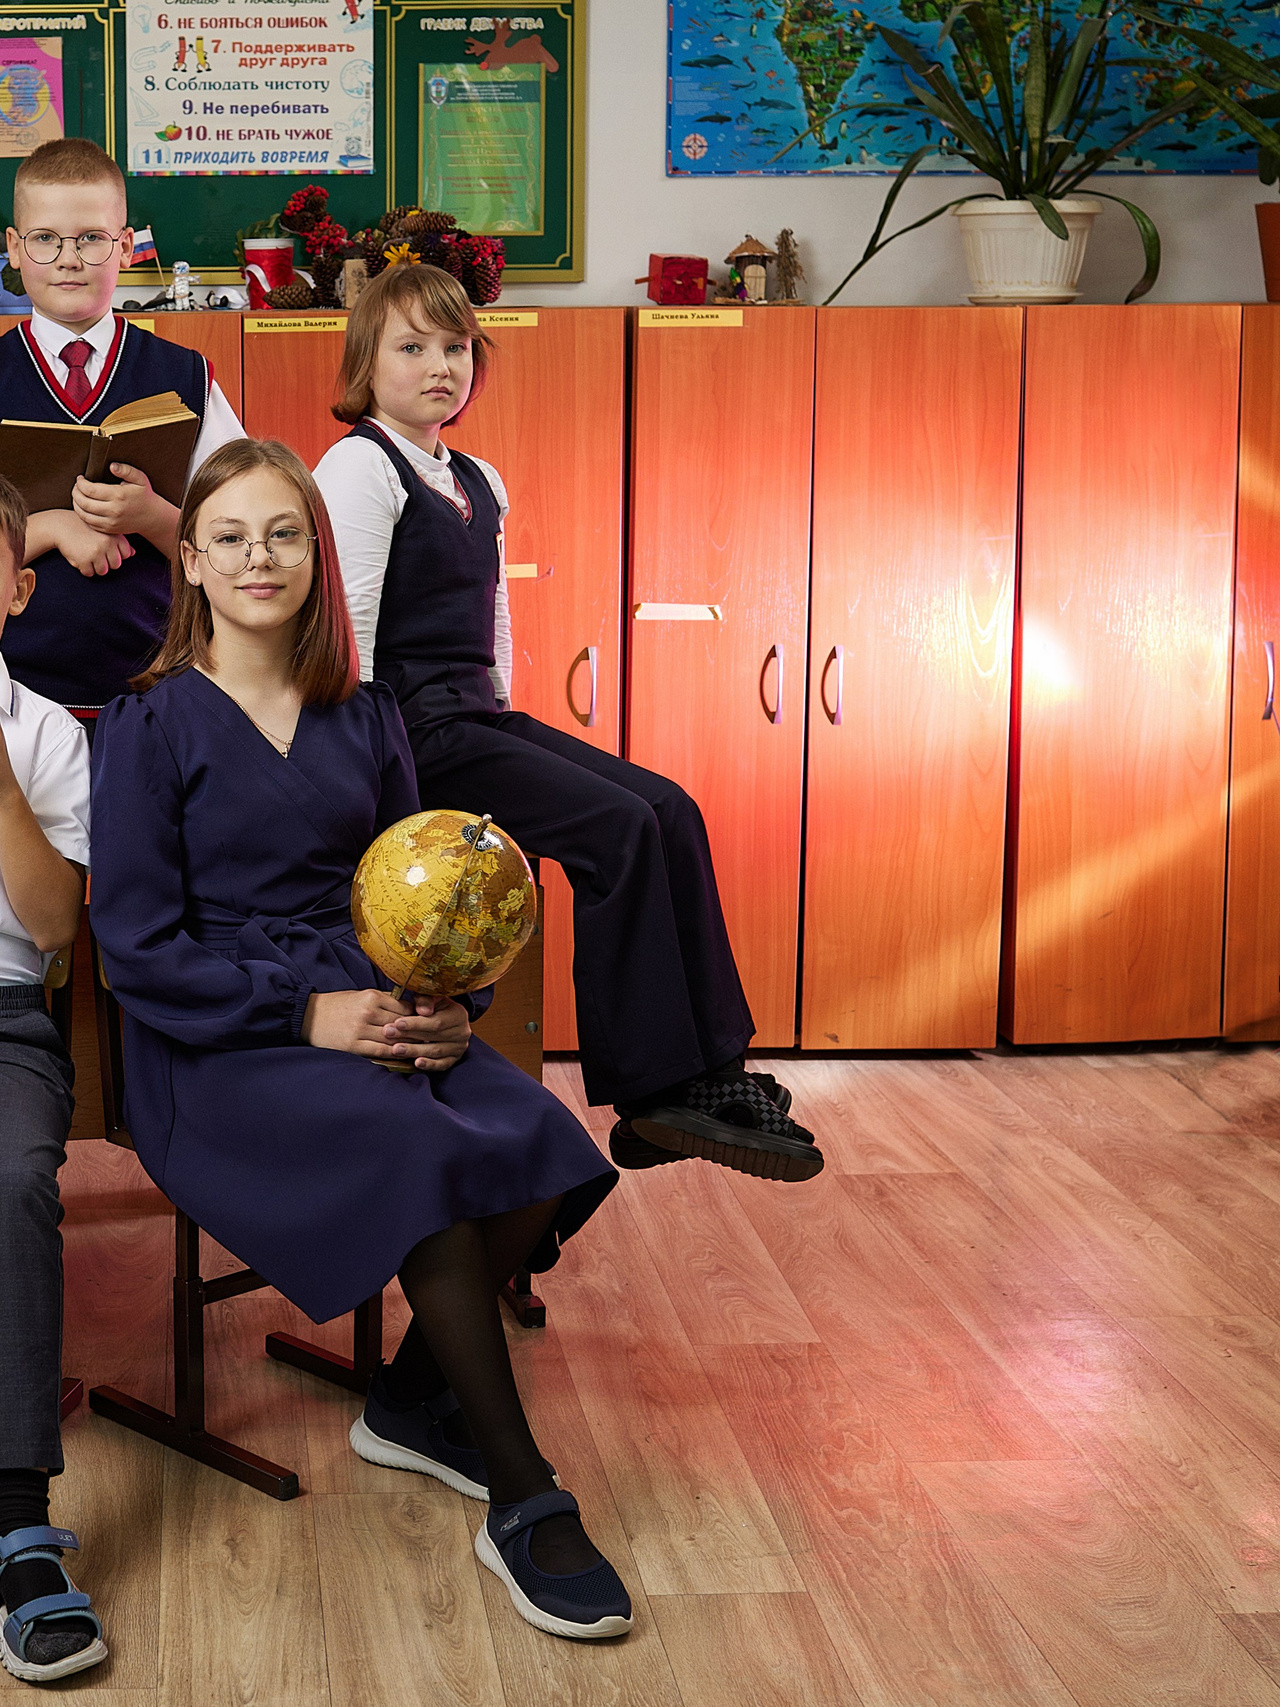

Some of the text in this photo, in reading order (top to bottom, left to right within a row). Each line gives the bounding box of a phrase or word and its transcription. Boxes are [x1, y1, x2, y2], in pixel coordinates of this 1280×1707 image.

[157, 13, 328, 29] 6. НЕ БОЯТЬСЯ ОШИБОК
[420, 16, 545, 31] ГРАФИК ДЕЖУСТВА
[211, 39, 355, 55] 7. Поддерживать
[238, 56, 327, 68] друг друга
[144, 75, 330, 92] 8. Соблюдать чистоту
[182, 99, 329, 116] 9. Не перебивать
[184, 125, 333, 141] 10. НЕ БРАТЬ ЧУЖОЕ
[142, 149, 329, 164] 11. ПРИХОДИТЬ ВОВРЕМЯ
[256, 319, 338, 328] Михайлова Валерия
[494, 315, 520, 323] Ксения
